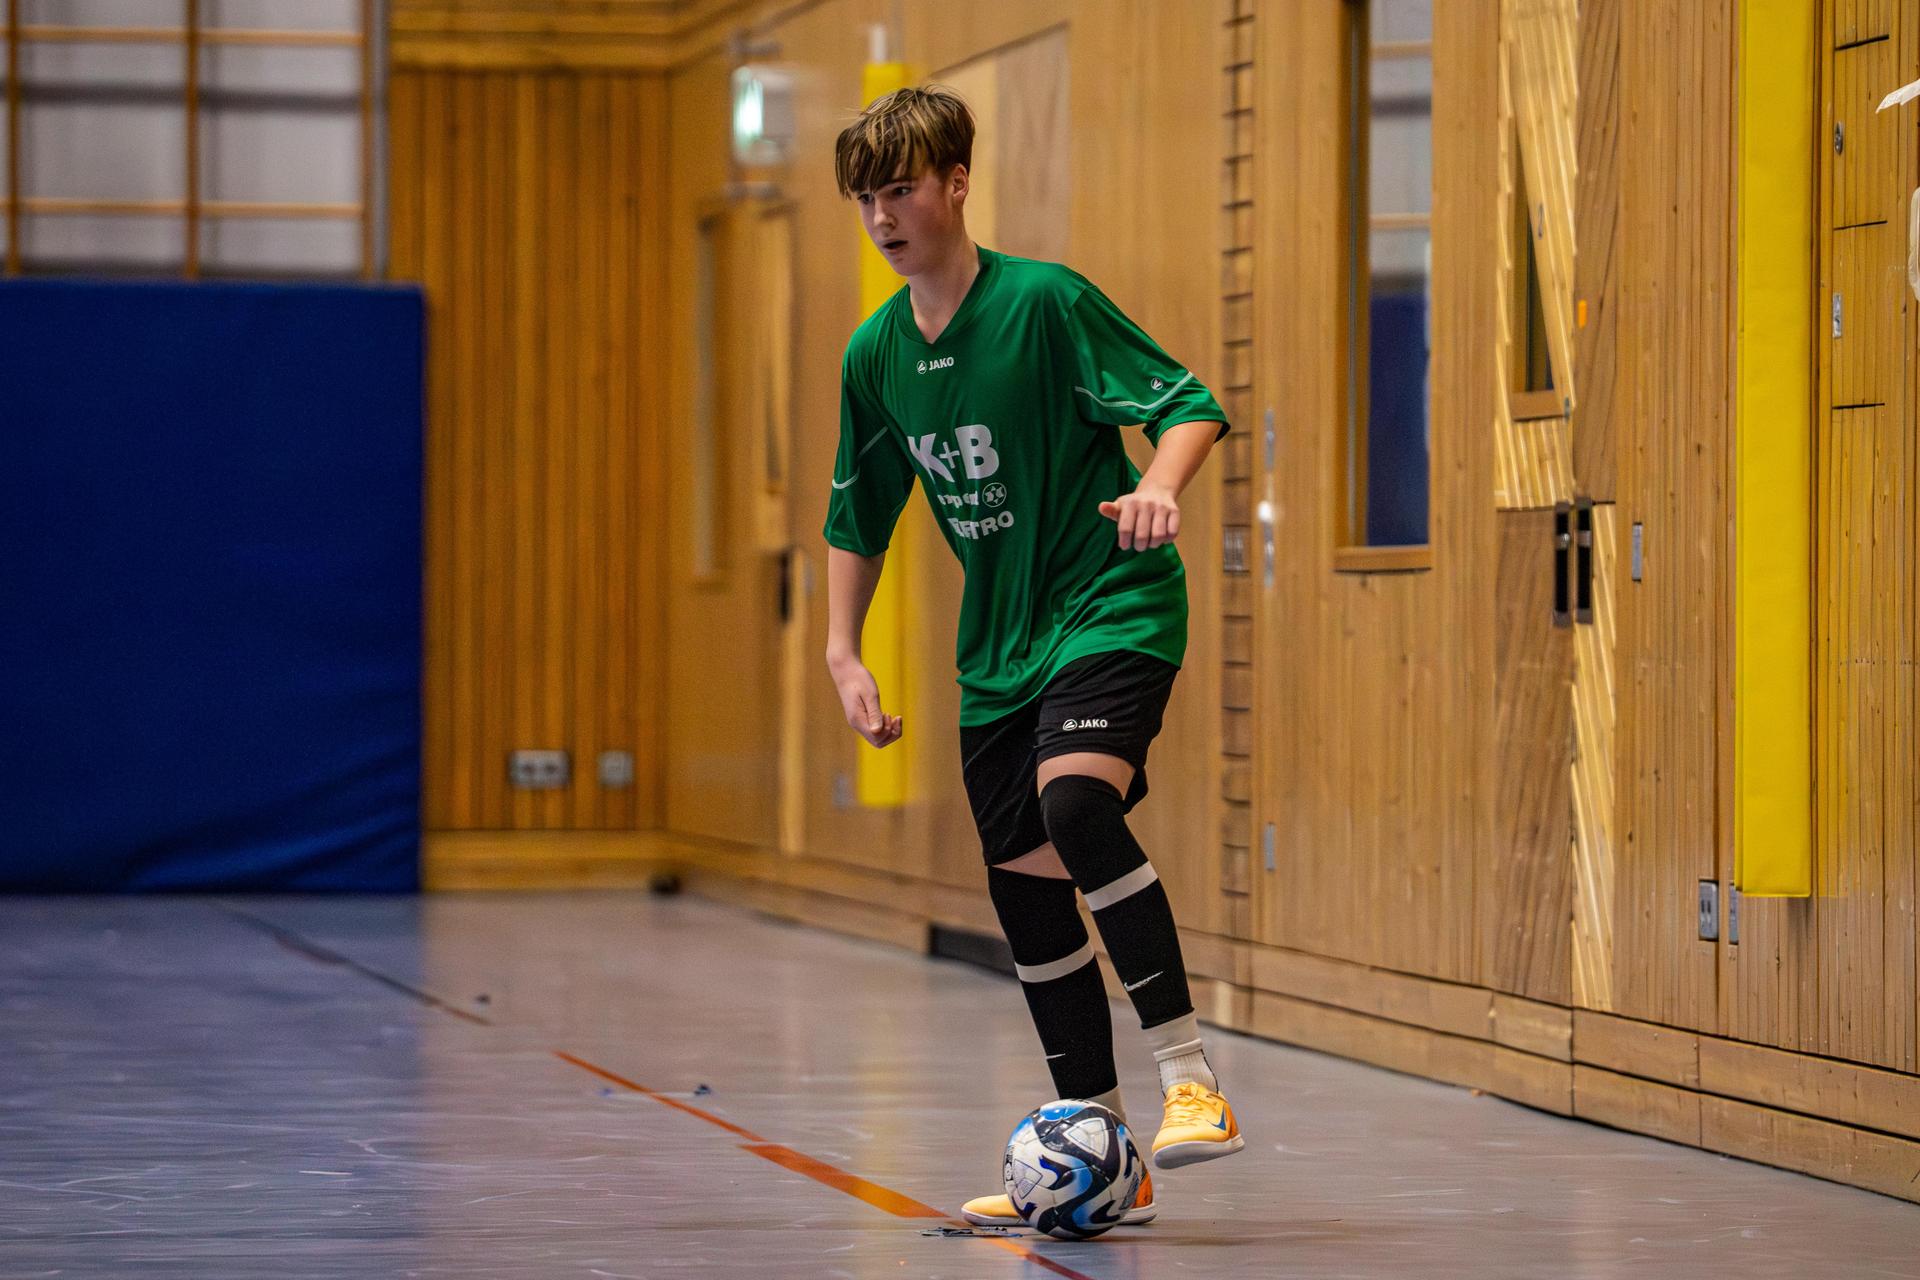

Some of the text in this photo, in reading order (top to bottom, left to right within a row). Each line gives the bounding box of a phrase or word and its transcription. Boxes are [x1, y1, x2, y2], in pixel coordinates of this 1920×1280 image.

[929, 357, 954, 370] JAKO
[907, 424, 999, 484] K+B
[1079, 719, 1108, 728] JAKO
